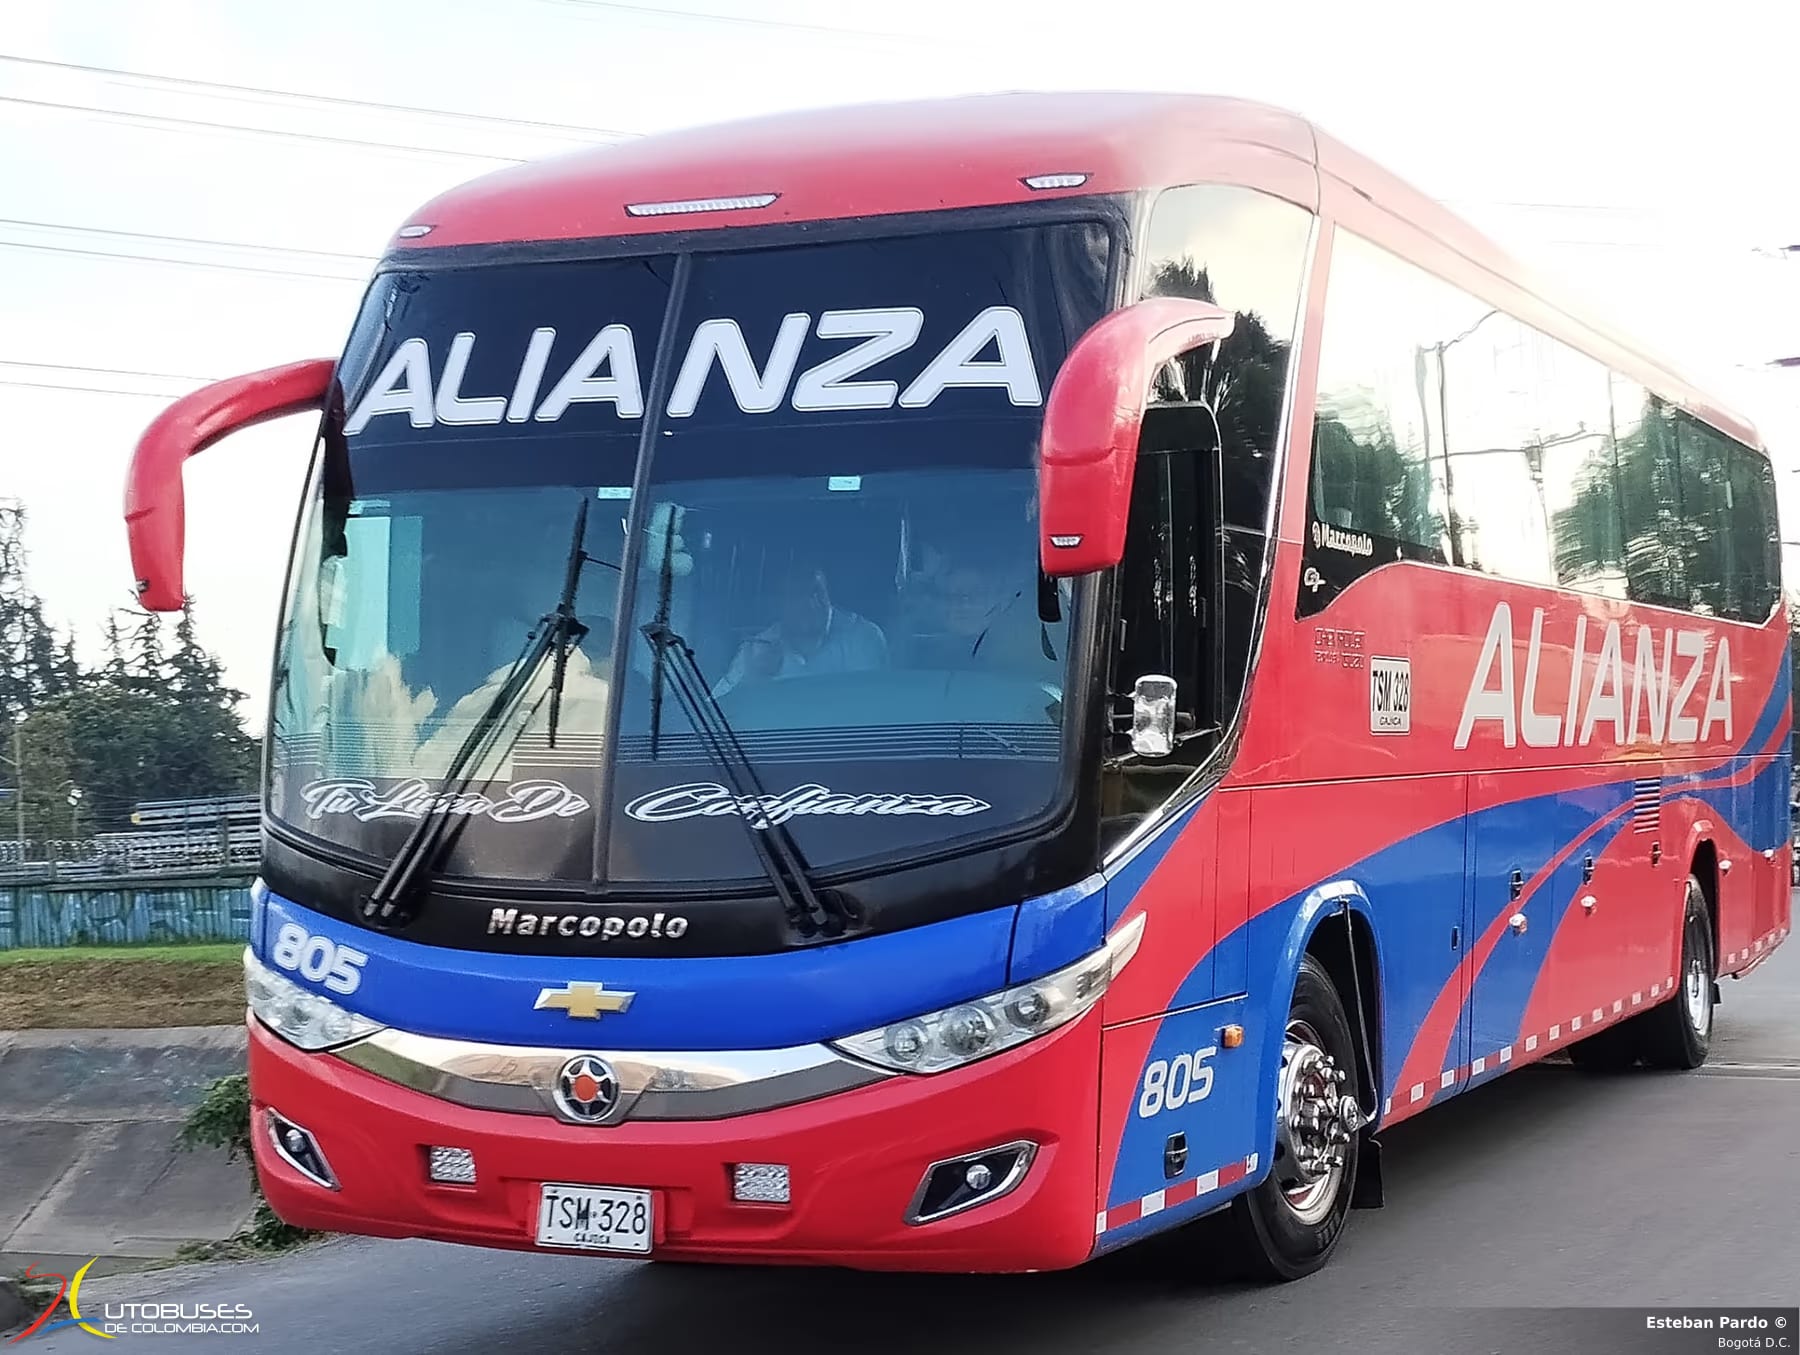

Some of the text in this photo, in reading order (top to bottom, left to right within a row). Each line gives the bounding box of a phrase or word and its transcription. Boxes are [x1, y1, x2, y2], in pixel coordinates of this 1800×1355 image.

[343, 306, 1043, 436] ALIANZA
[1322, 523, 1373, 556] Marcopolo
[1454, 601, 1733, 749] ALIANZA
[624, 782, 992, 830] Confianza
[274, 922, 369, 995] 805
[487, 908, 688, 941] Marcopolo
[1138, 1046, 1217, 1118] 805
